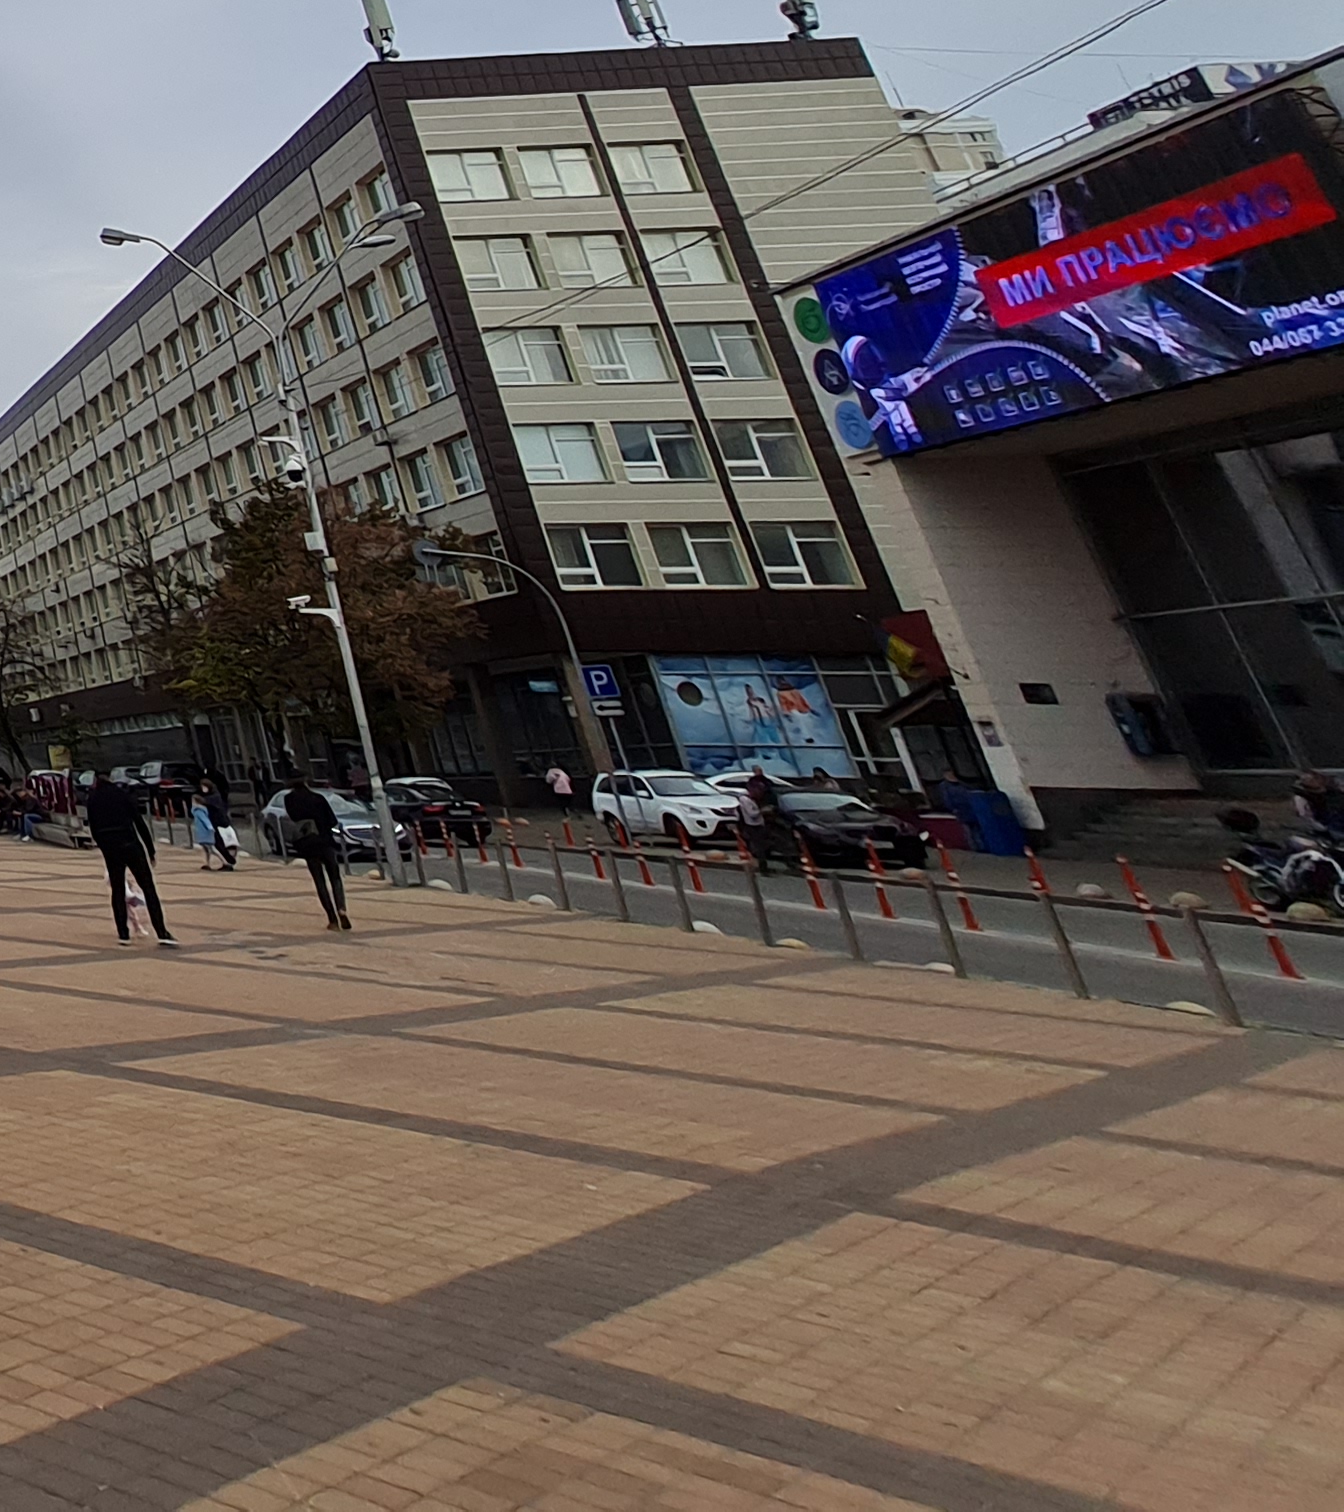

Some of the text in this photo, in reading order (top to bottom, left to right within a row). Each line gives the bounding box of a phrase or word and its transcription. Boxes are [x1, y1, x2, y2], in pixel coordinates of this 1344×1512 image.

[998, 265, 1055, 307] МИ
[1055, 182, 1293, 288] ПРАЦЮЄМО
[589, 670, 609, 695] P
